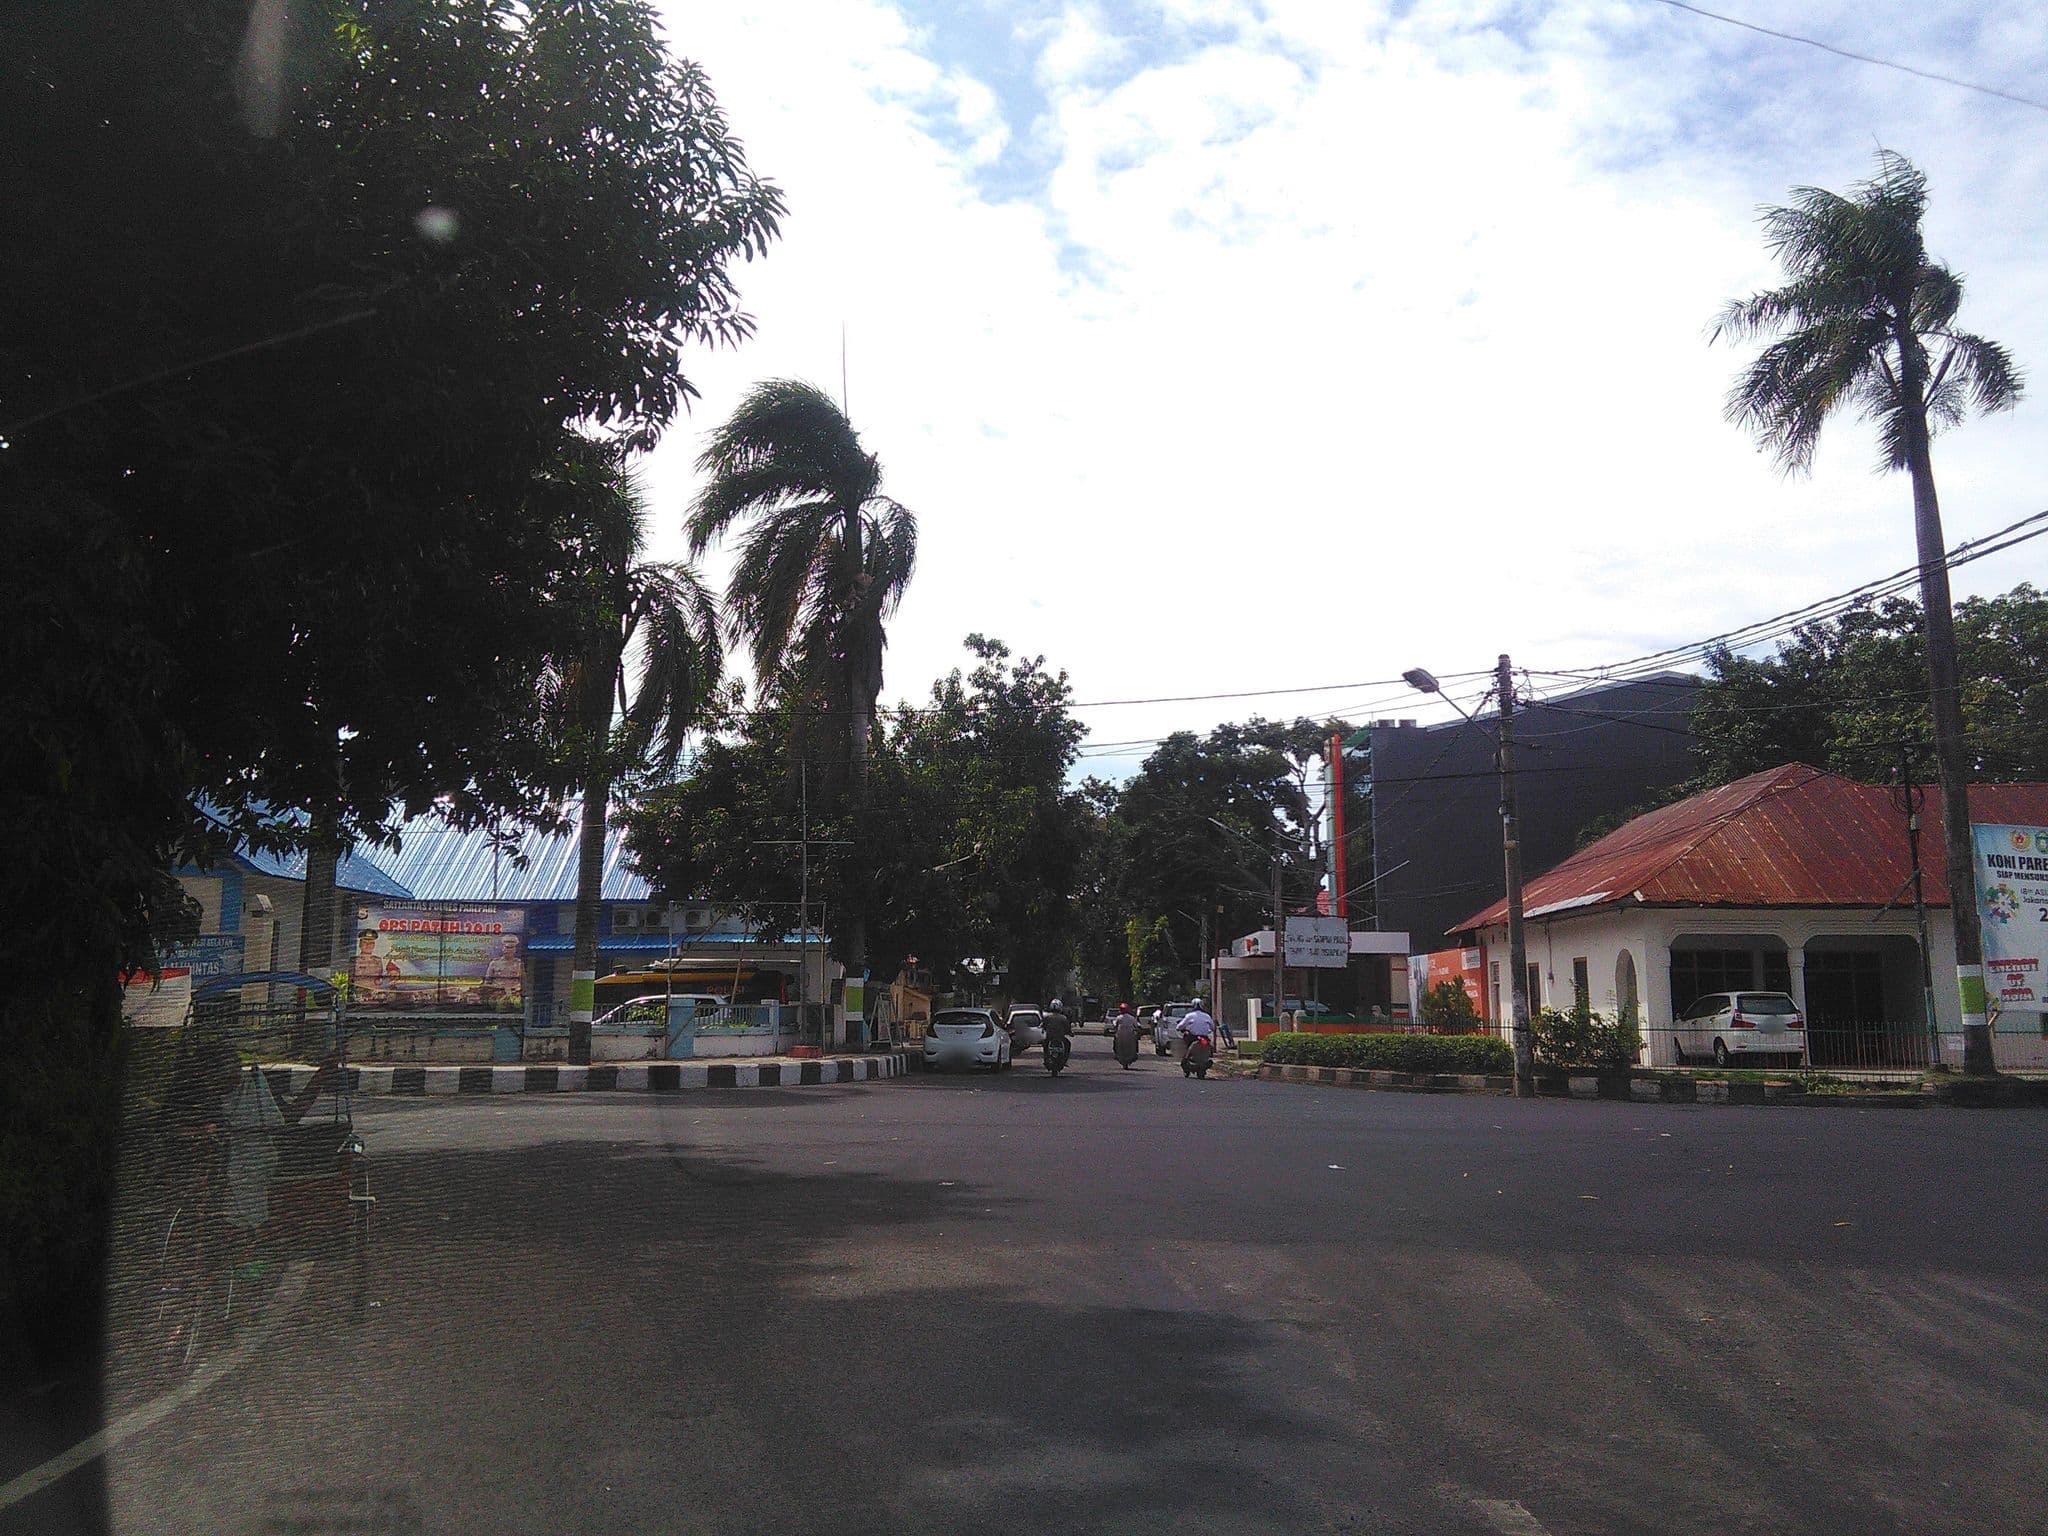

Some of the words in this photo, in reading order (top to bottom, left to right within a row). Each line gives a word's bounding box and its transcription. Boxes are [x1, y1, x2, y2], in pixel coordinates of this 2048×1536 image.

[1986, 853, 2016, 869] KONI
[1996, 870, 2013, 879] SIAP
[428, 902, 458, 912] POLRES
[459, 903, 497, 914] PAREPARE
[378, 918, 407, 933] OPS
[410, 919, 461, 935] PATUH
[463, 921, 503, 936] 2018
